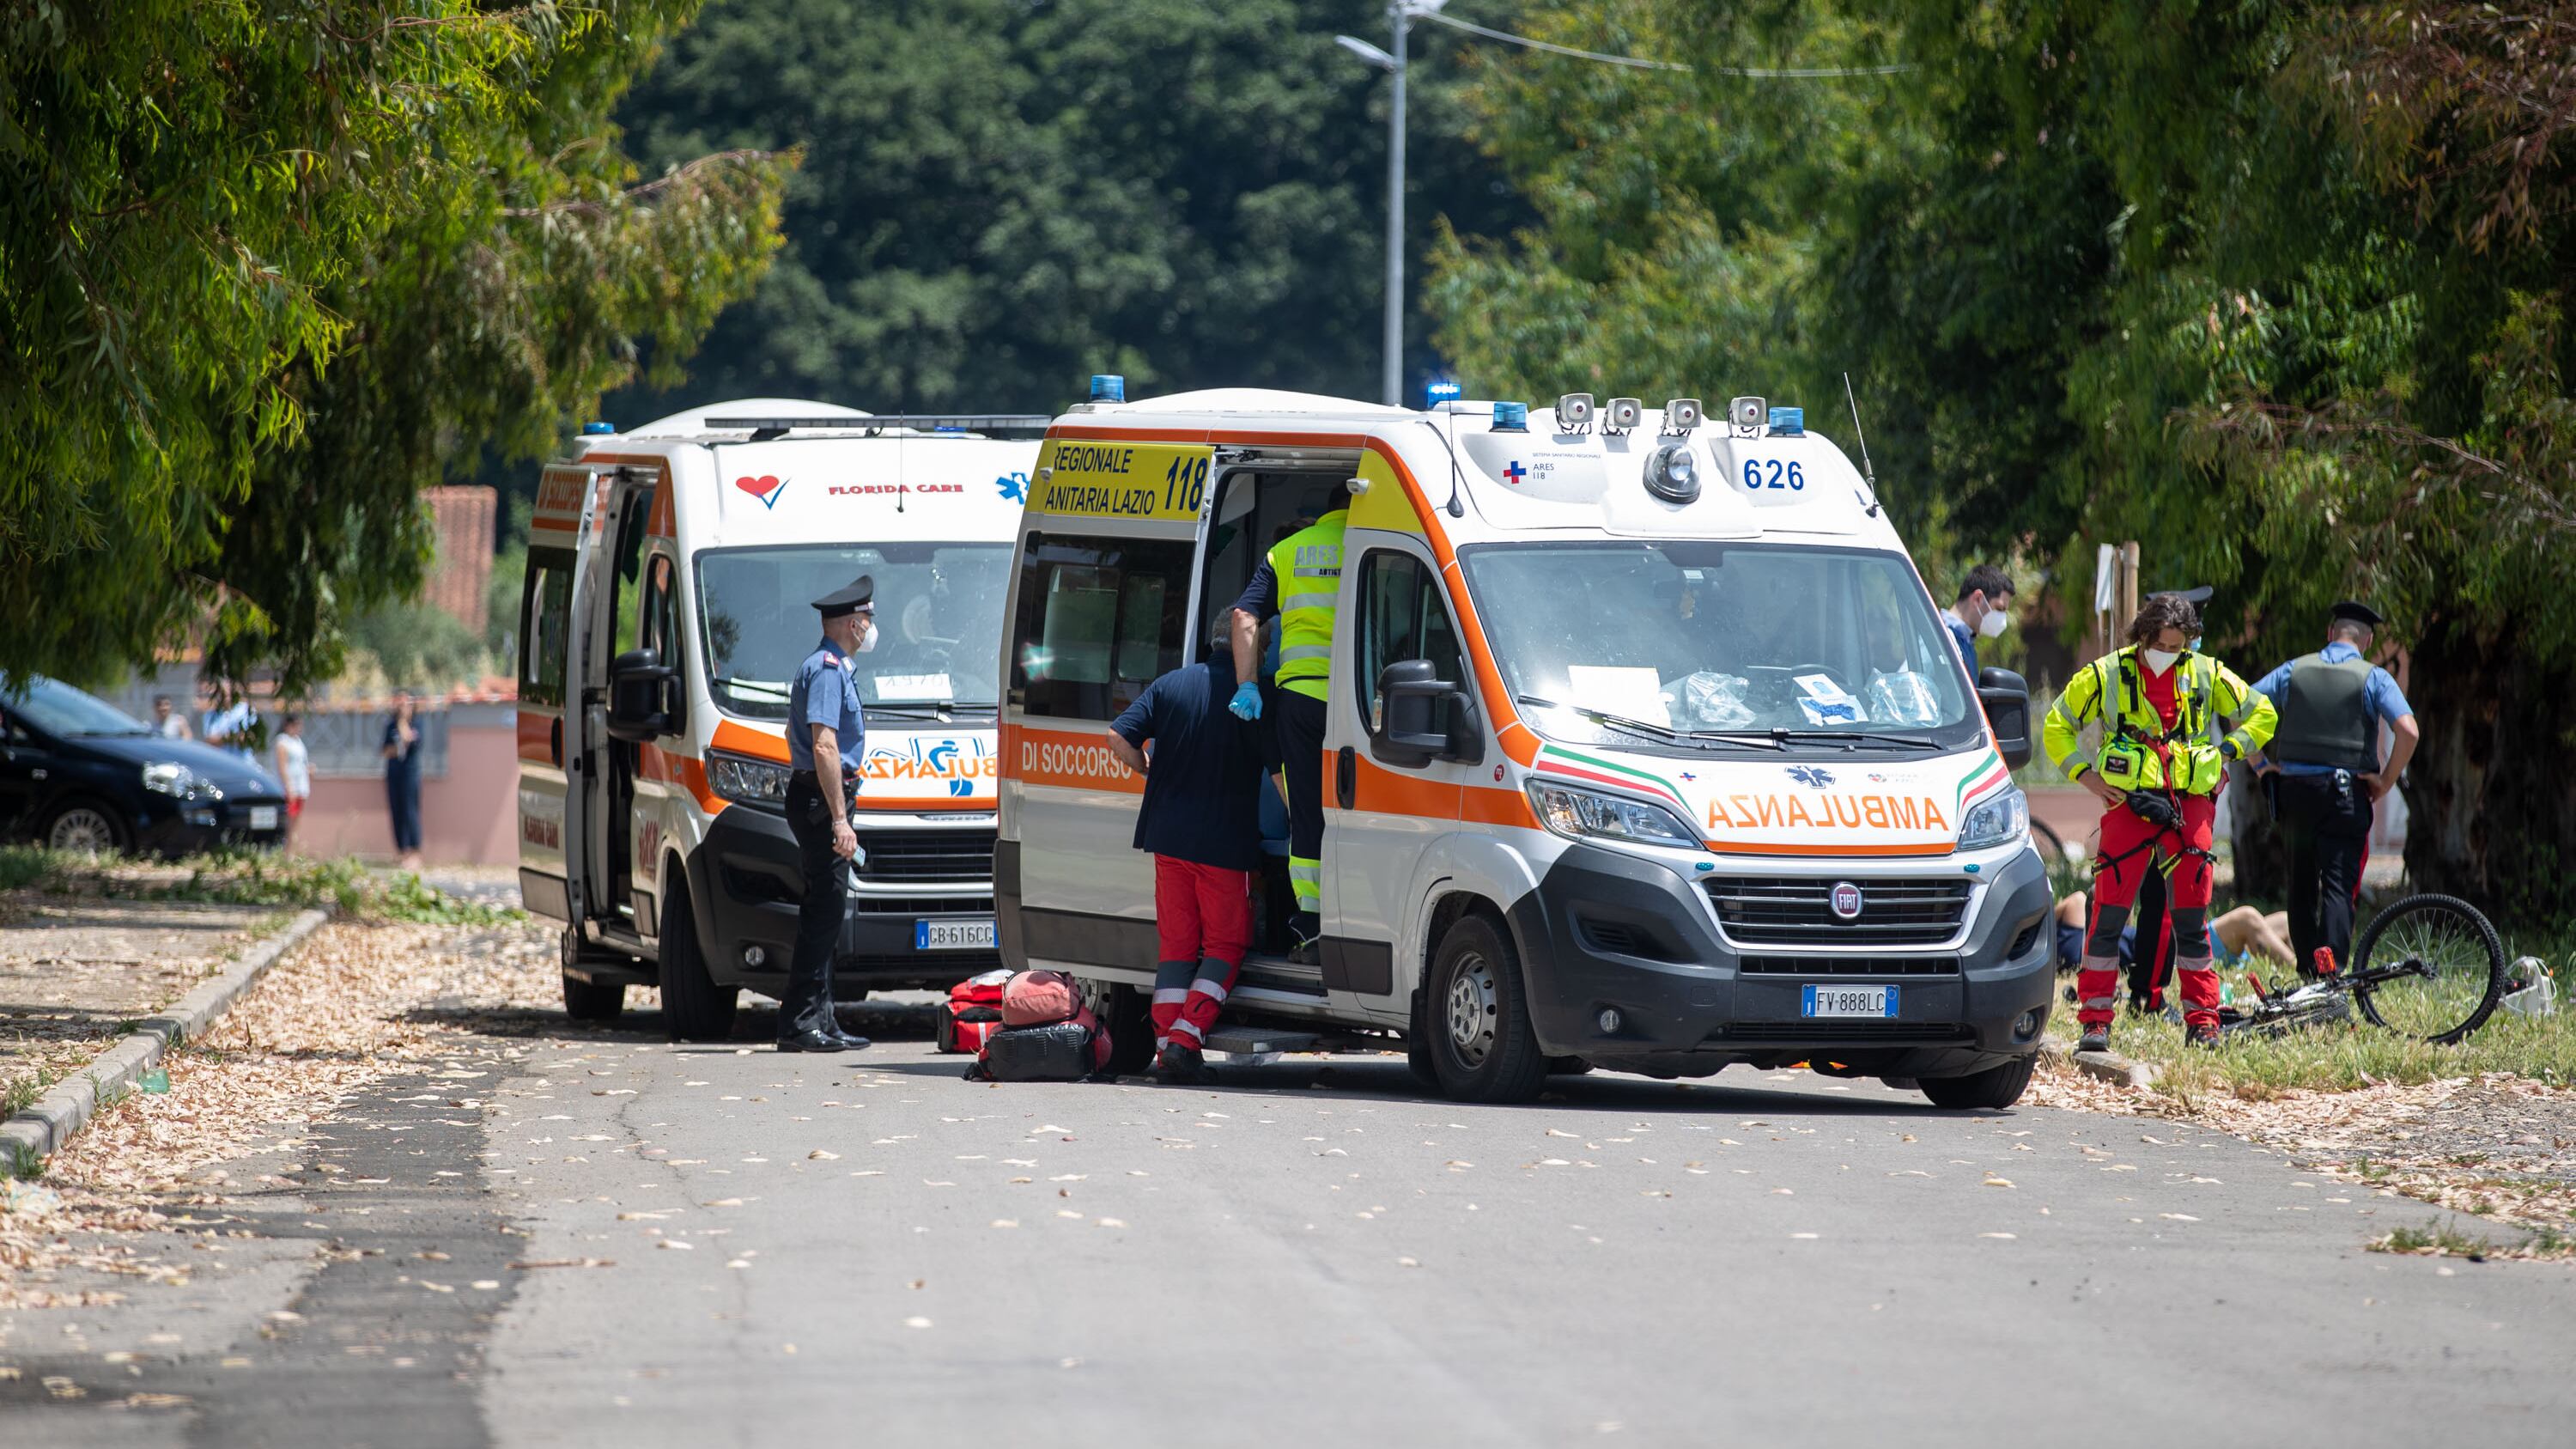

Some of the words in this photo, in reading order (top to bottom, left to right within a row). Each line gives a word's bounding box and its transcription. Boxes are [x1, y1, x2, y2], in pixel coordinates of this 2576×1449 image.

[829, 484, 911, 496] FLORIDA
[916, 484, 963, 493] CARE
[1165, 456, 1208, 512] 118
[1744, 459, 1804, 491] 626
[1045, 485, 1109, 513] ANITARIA
[1112, 488, 1155, 515] LAZIO
[1294, 544, 1339, 566] ARES
[1023, 741, 1037, 771] DI
[1838, 893, 1856, 910] FIAT
